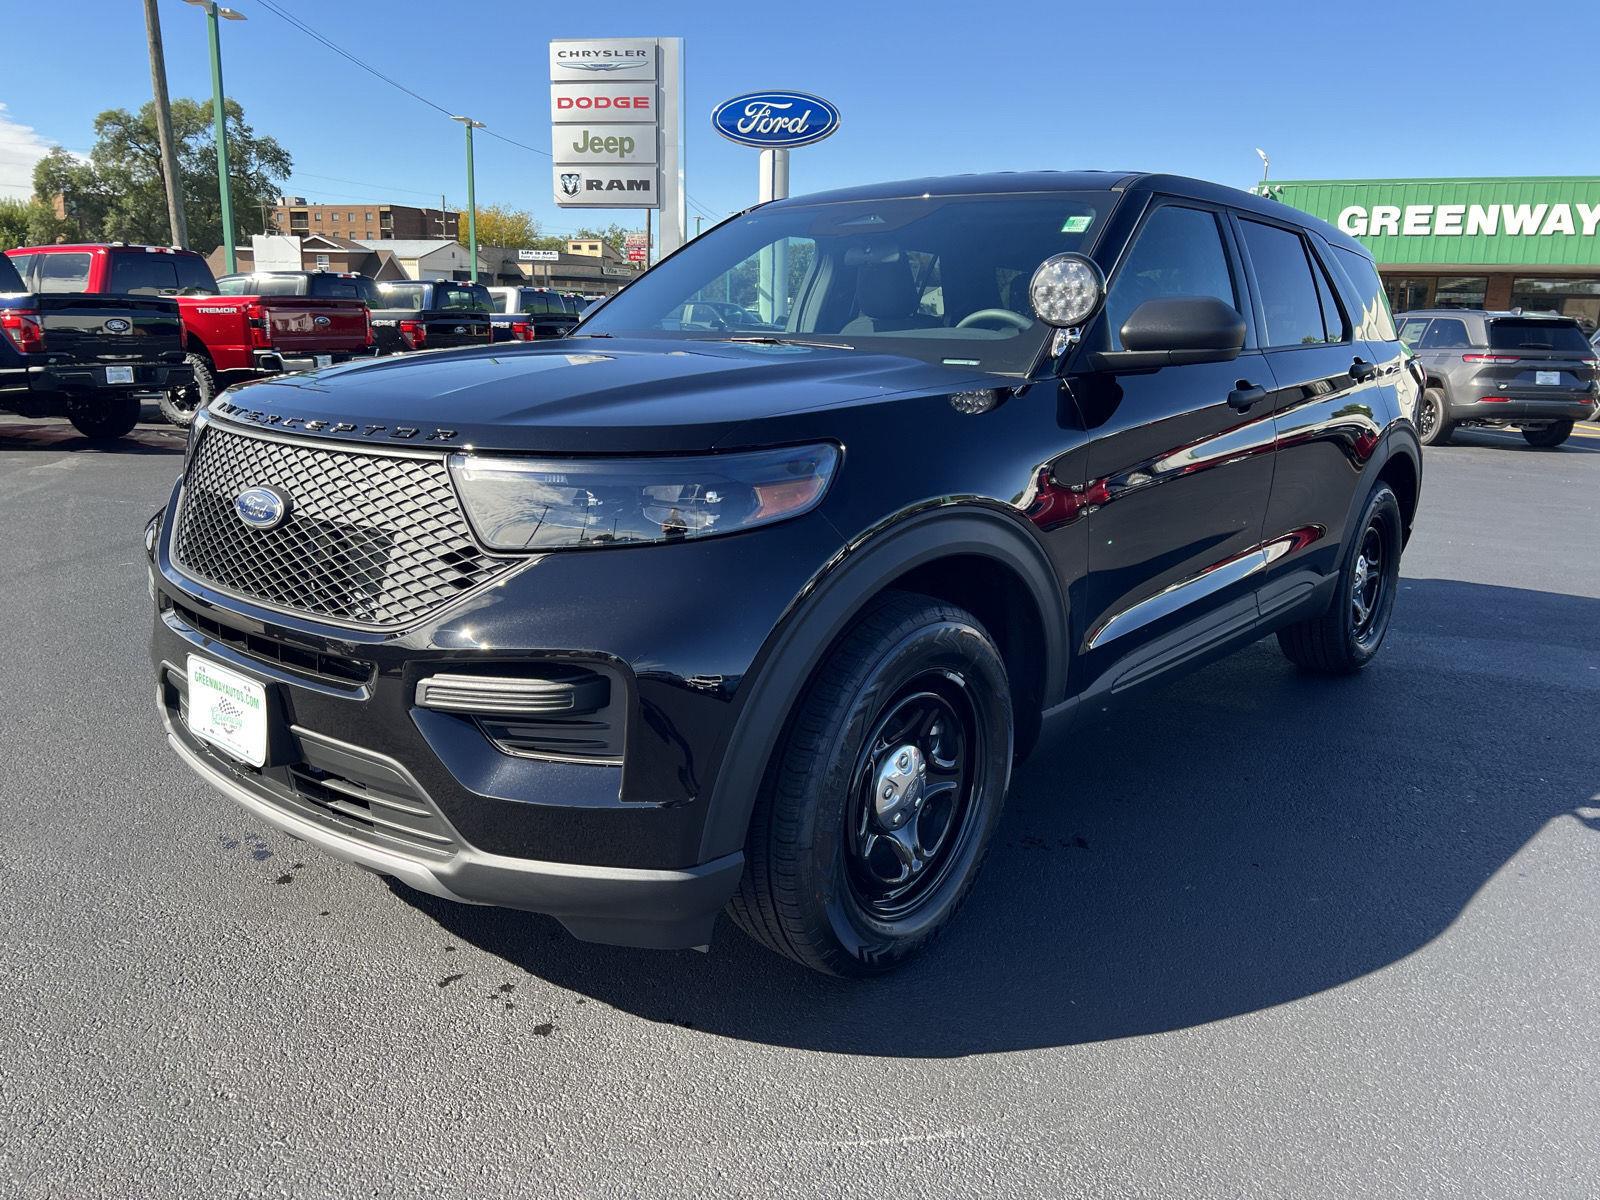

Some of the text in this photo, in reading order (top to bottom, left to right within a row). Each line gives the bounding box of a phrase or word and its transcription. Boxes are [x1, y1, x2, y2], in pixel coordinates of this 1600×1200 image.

[557, 49, 647, 58] CHRYSLER
[557, 96, 650, 109] DODGE
[737, 101, 811, 134] Ford
[572, 130, 635, 158] Jeep
[585, 179, 651, 191] RAM
[1337, 203, 1600, 237] GREENWAY
[217, 402, 458, 442] INTERCEPTOR
[243, 495, 268, 519] Ford
[194, 671, 260, 710] GREENWAYAUTOS.COM
